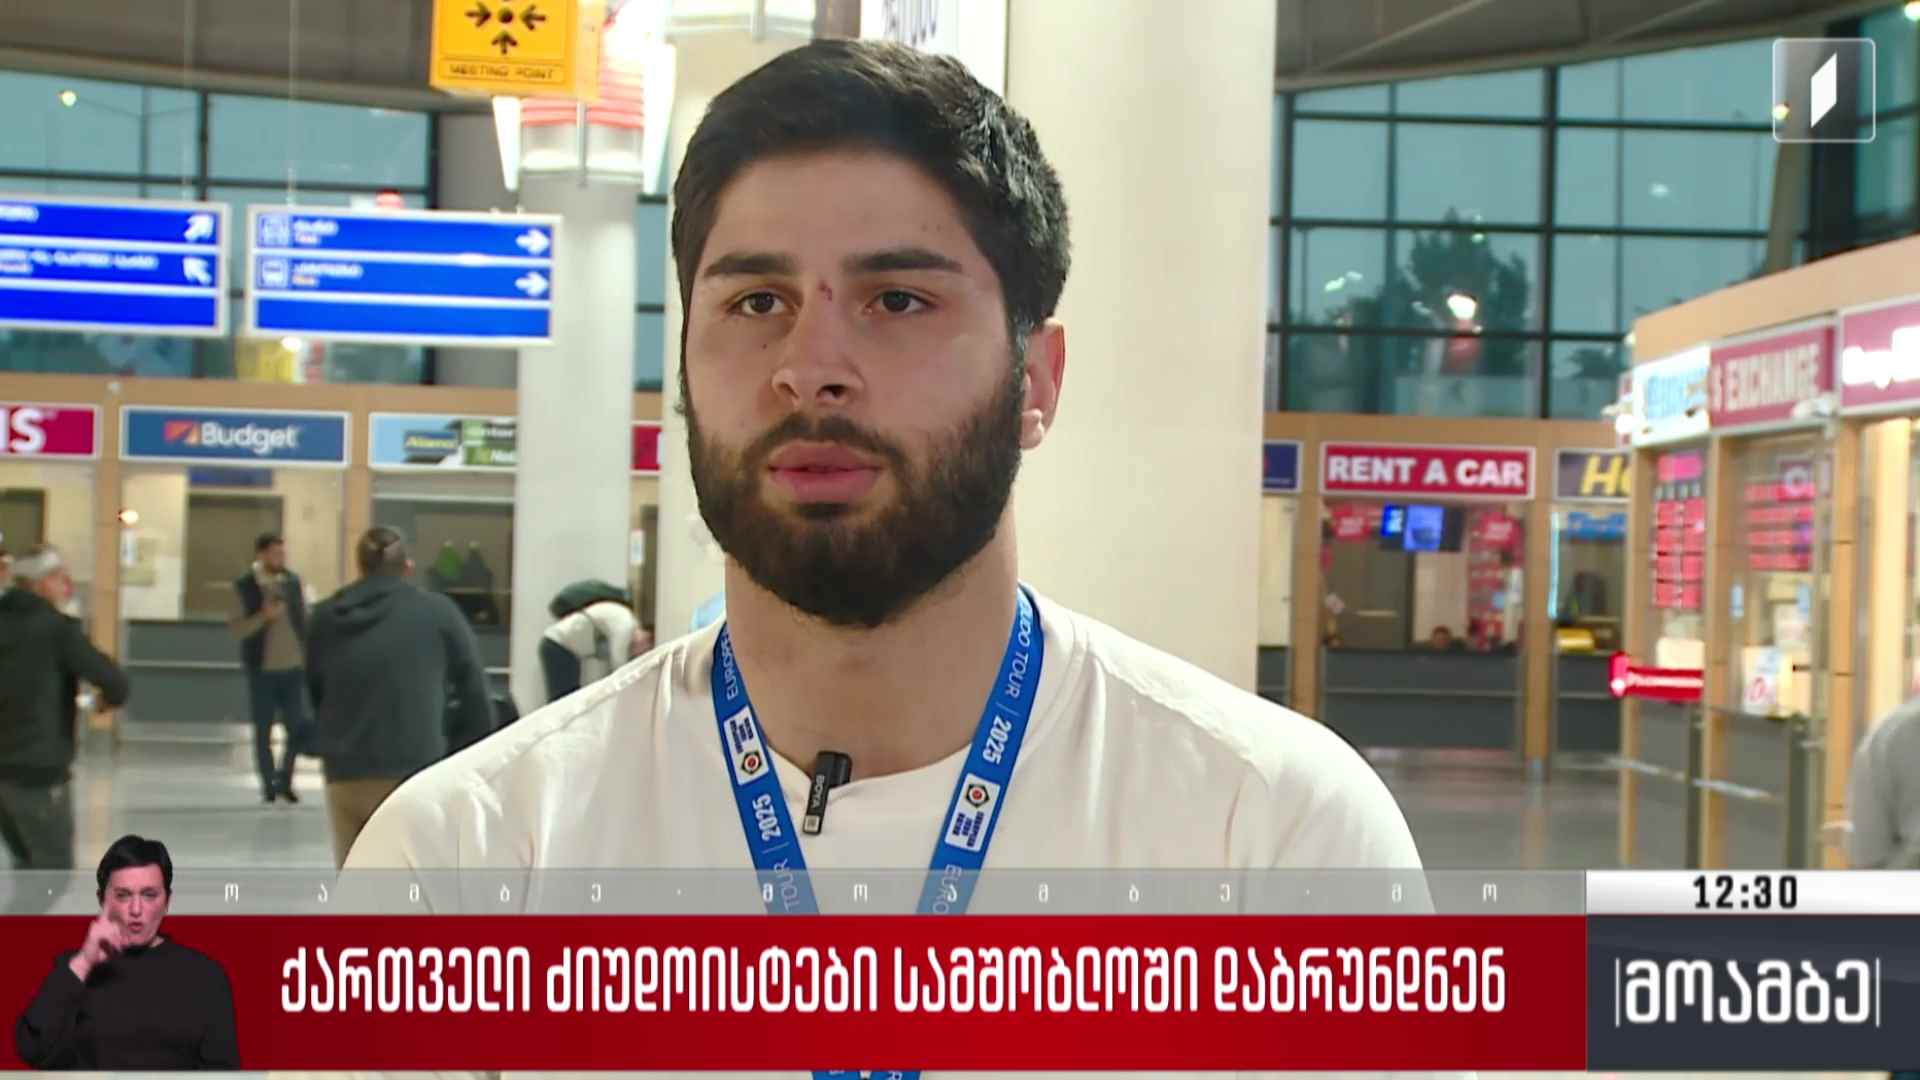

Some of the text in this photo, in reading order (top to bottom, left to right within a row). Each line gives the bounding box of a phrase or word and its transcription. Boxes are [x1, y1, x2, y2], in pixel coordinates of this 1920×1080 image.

[1725, 342, 1821, 412] EXCHANGE
[201, 421, 298, 455] Budget
[1327, 456, 1525, 488] RENT A CAR
[1004, 651, 1030, 698] TOUR
[982, 715, 1013, 765] 2025
[811, 773, 826, 809] BOYA
[751, 793, 801, 912] TOUR 2025
